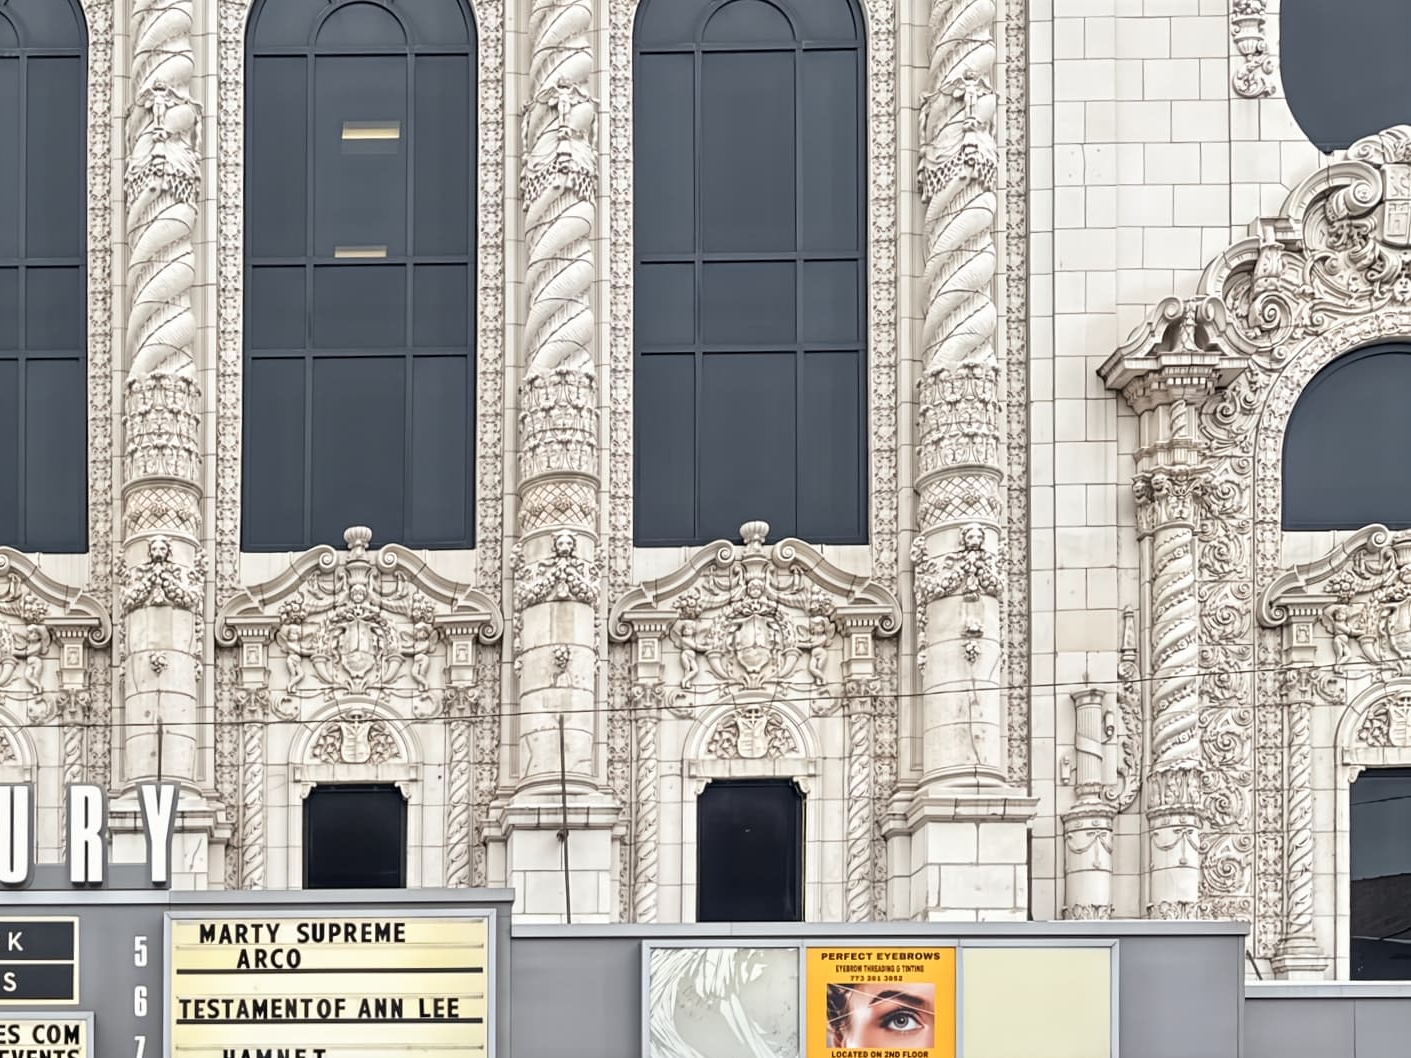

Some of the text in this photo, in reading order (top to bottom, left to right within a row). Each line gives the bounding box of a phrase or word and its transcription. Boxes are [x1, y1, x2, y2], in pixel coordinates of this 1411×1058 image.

[199, 922, 407, 944] MARTY SUPREME
[134, 936, 148, 967] 5
[236, 948, 302, 969] ARCO
[821, 952, 941, 960] PERFECT EYEBROWS
[134, 986, 148, 1017] 6
[358, 998, 404, 1019] ANN
[419, 998, 460, 1019] LEE
[33, 1024, 81, 1045] COM
[831, 1050, 929, 1058] LOCATED ON 2ND FLOOR
